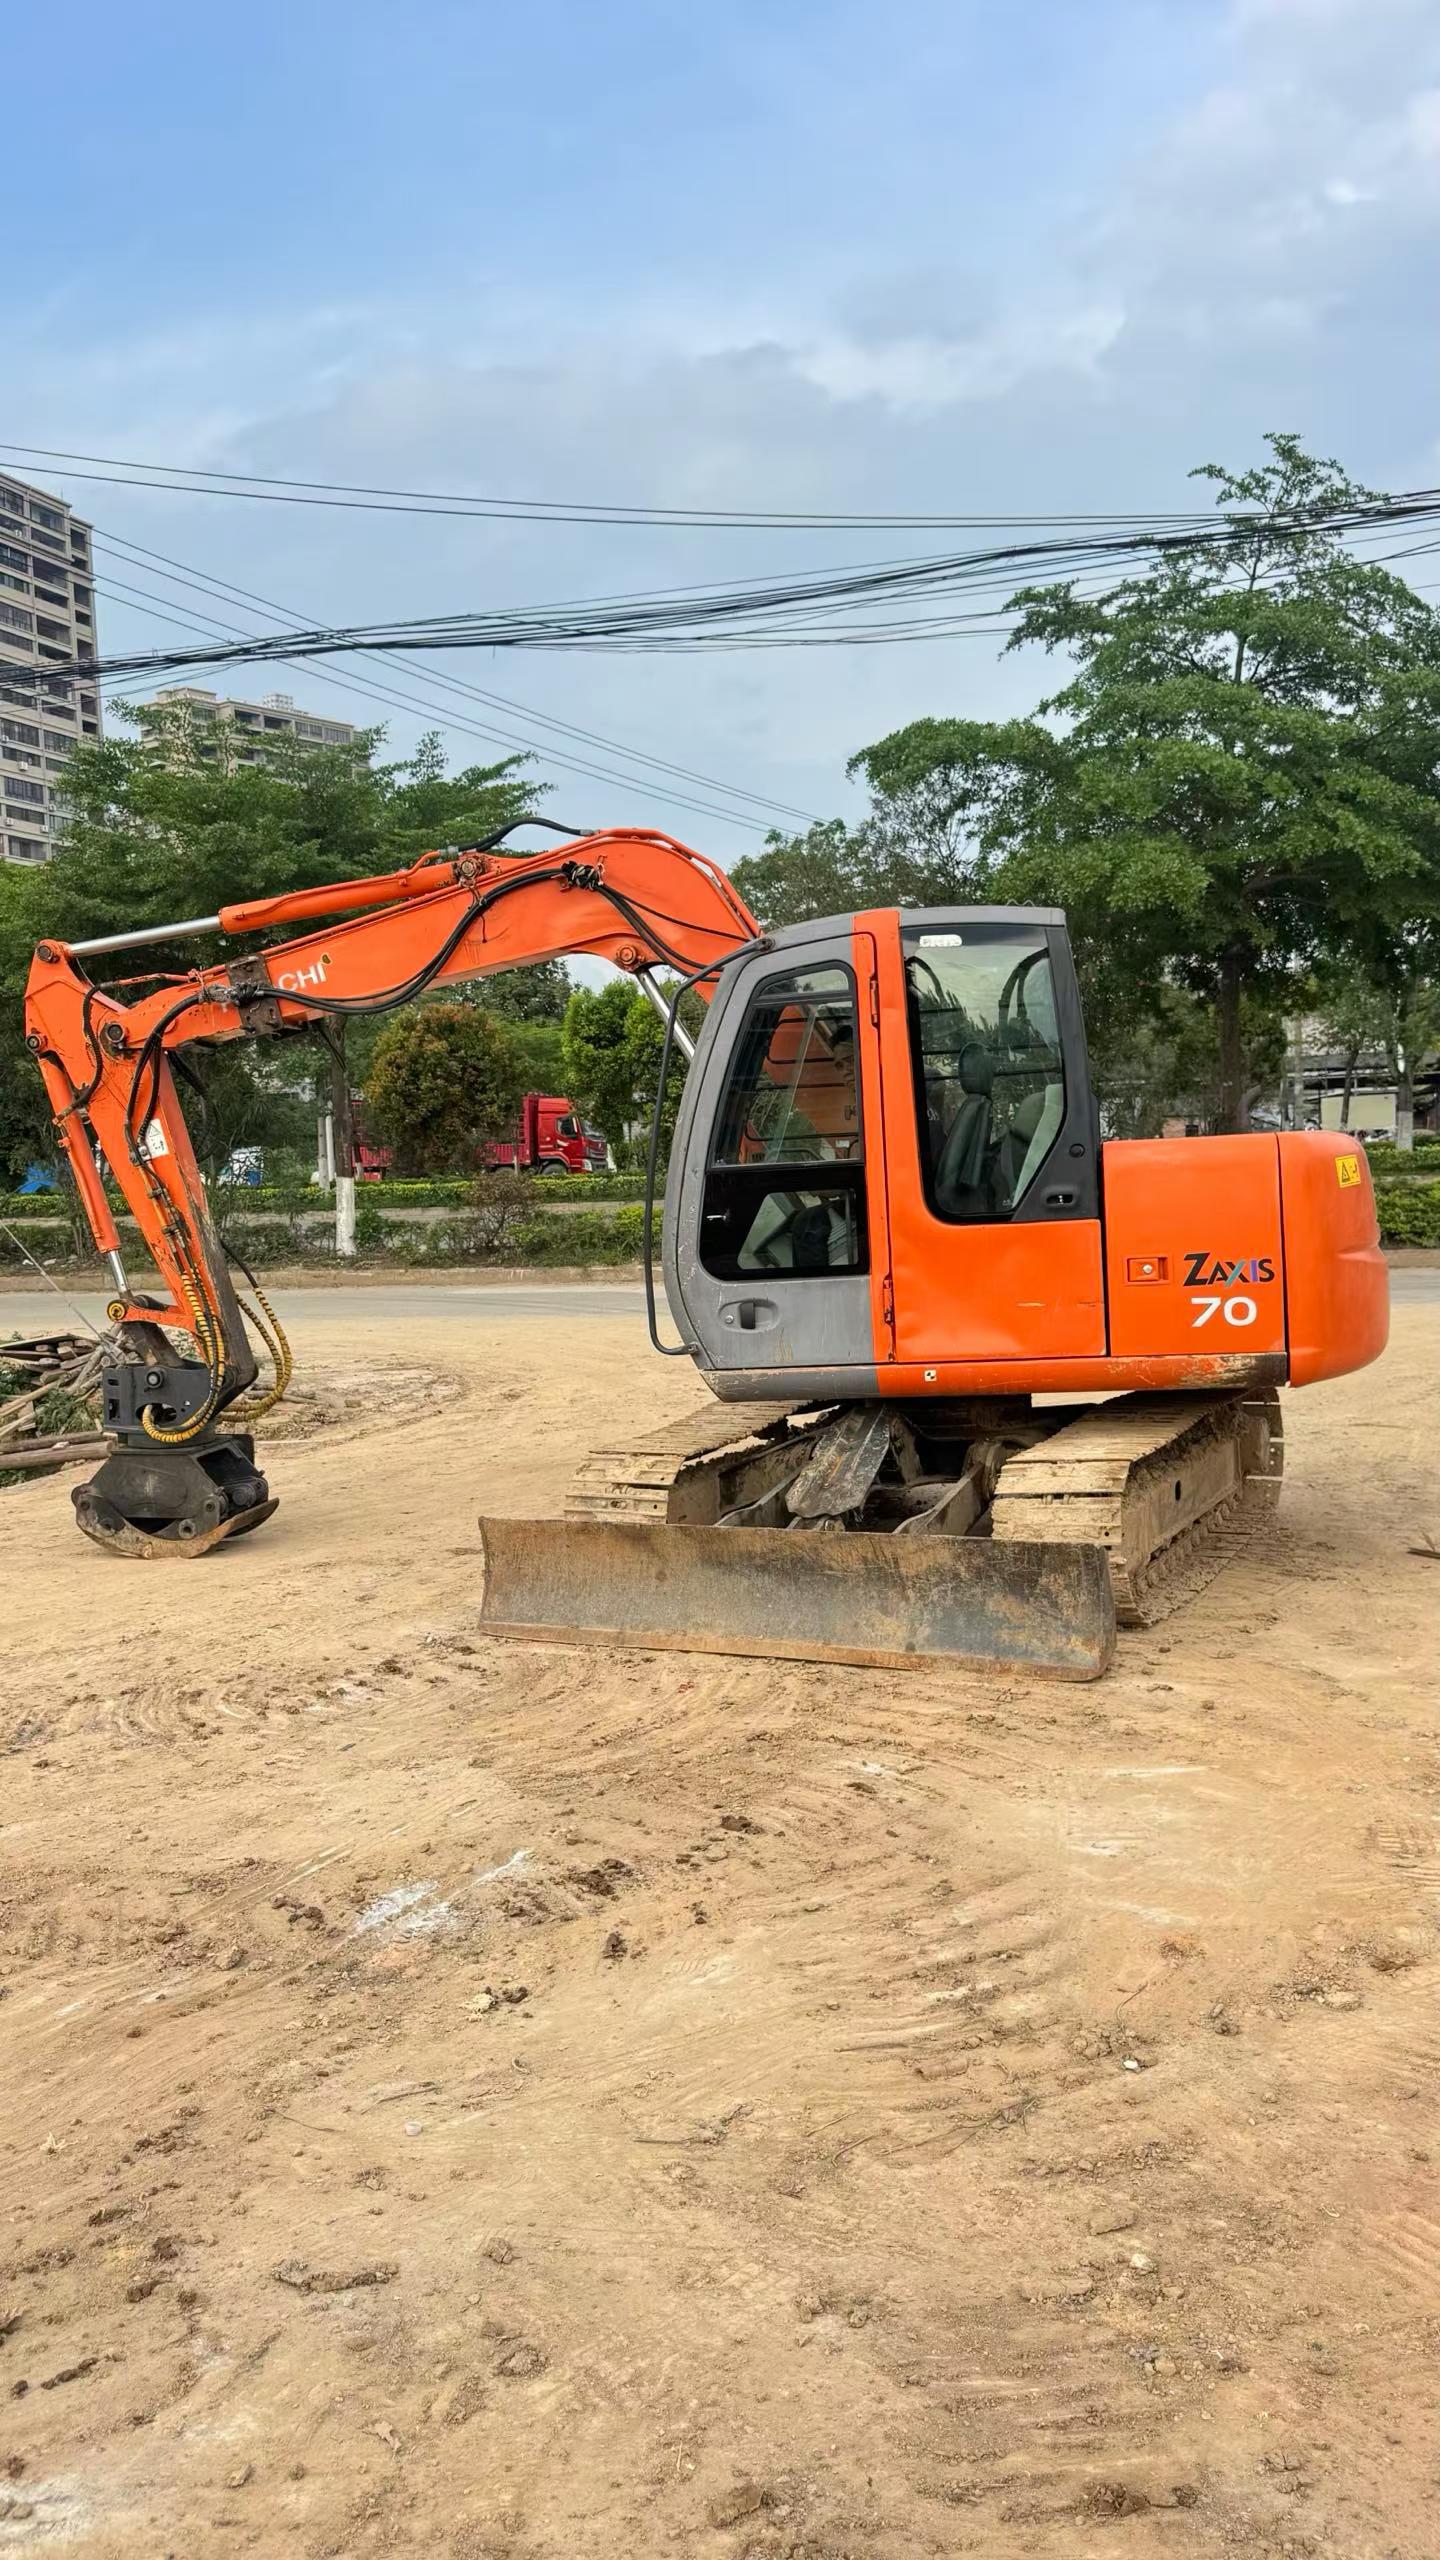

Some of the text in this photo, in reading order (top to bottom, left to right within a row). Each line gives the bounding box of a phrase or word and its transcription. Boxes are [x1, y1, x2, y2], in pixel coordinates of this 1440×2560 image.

[274, 961, 327, 991] CHI
[1183, 1252, 1275, 1288] ZAXIS
[1191, 1296, 1257, 1328] 70
